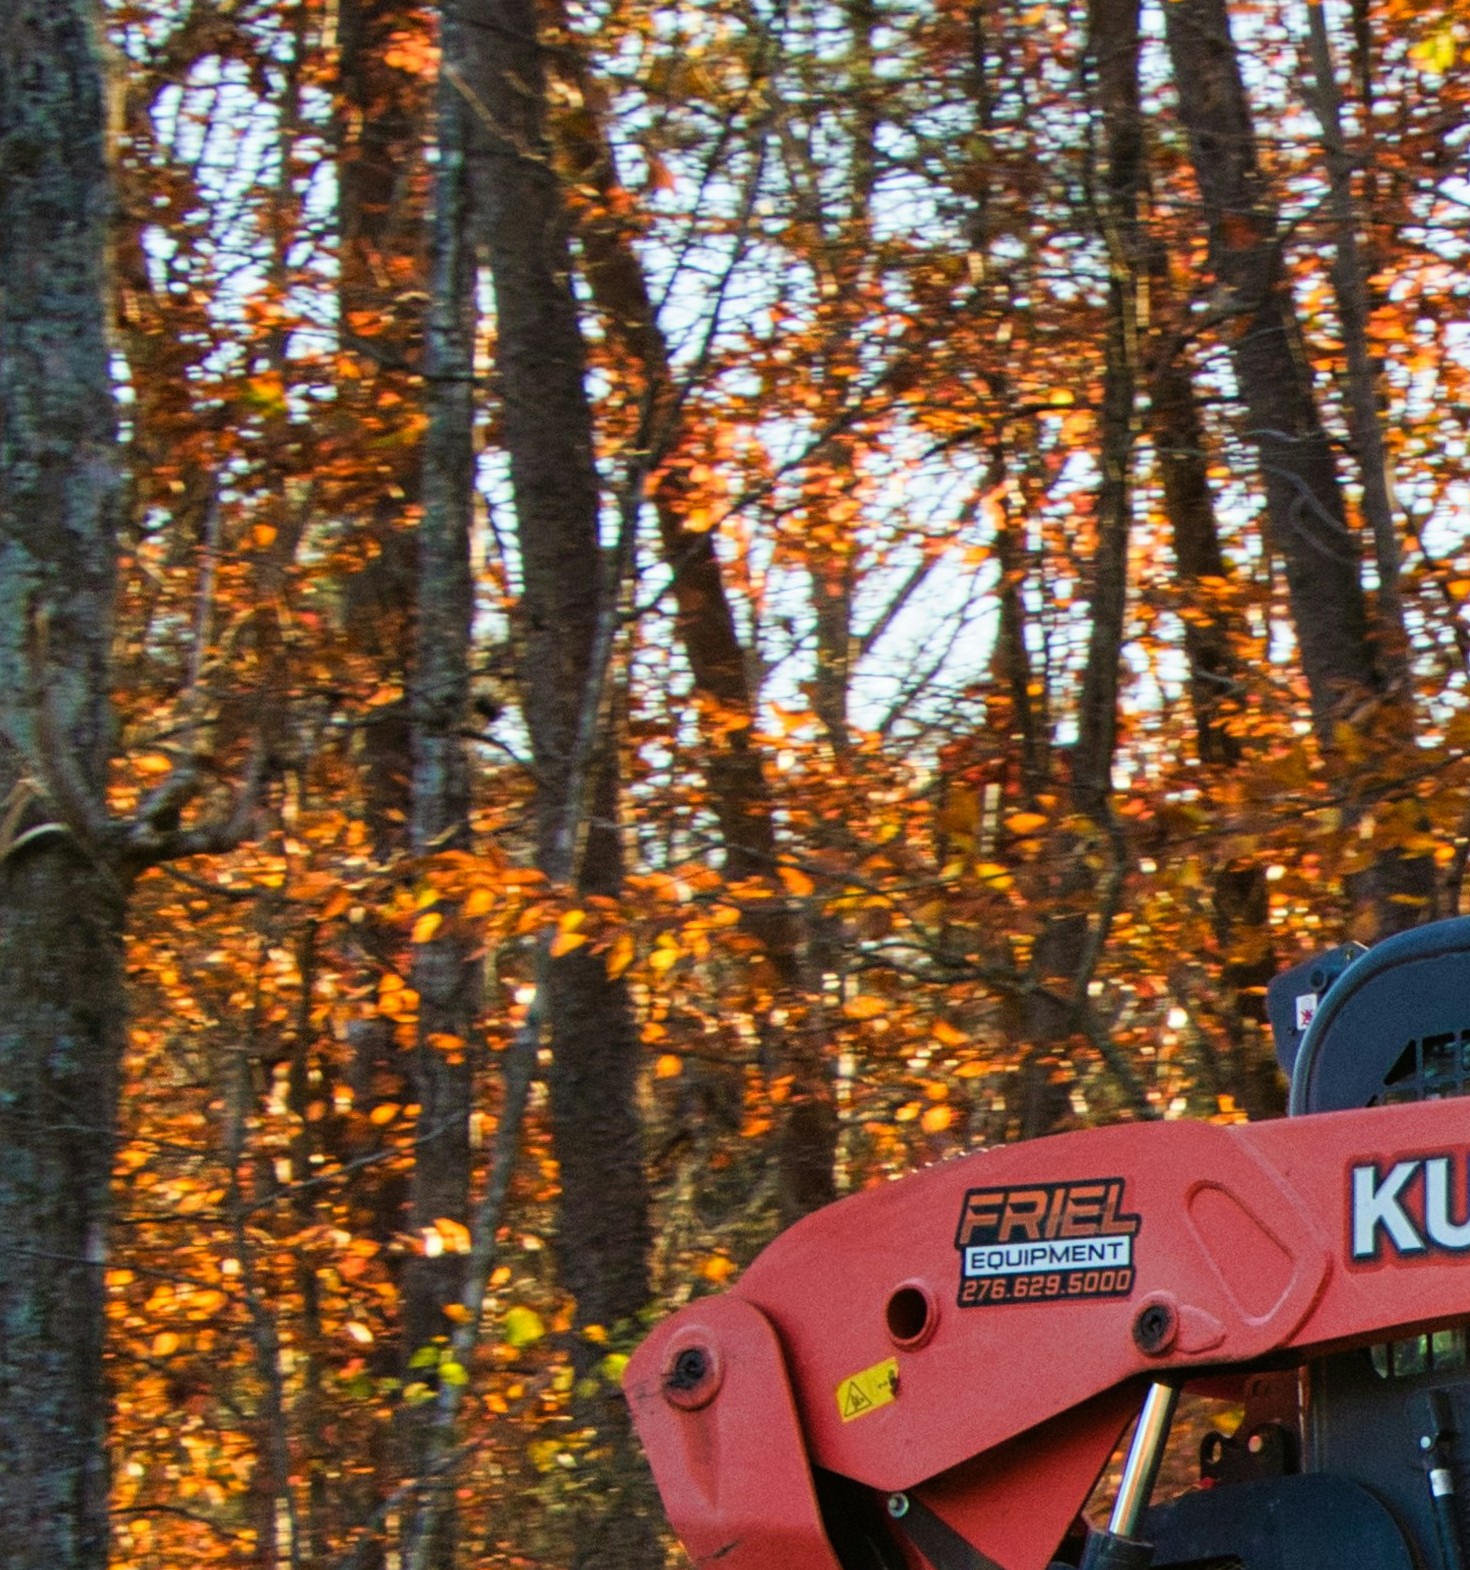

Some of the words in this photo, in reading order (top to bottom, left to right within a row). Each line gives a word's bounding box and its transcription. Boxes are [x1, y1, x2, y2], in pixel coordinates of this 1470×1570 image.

[960, 1184, 1137, 1244] FRIEL
[970, 1242, 1124, 1270] EQUIPMENT
[962, 1270, 1131, 1302] 276.629.5000
